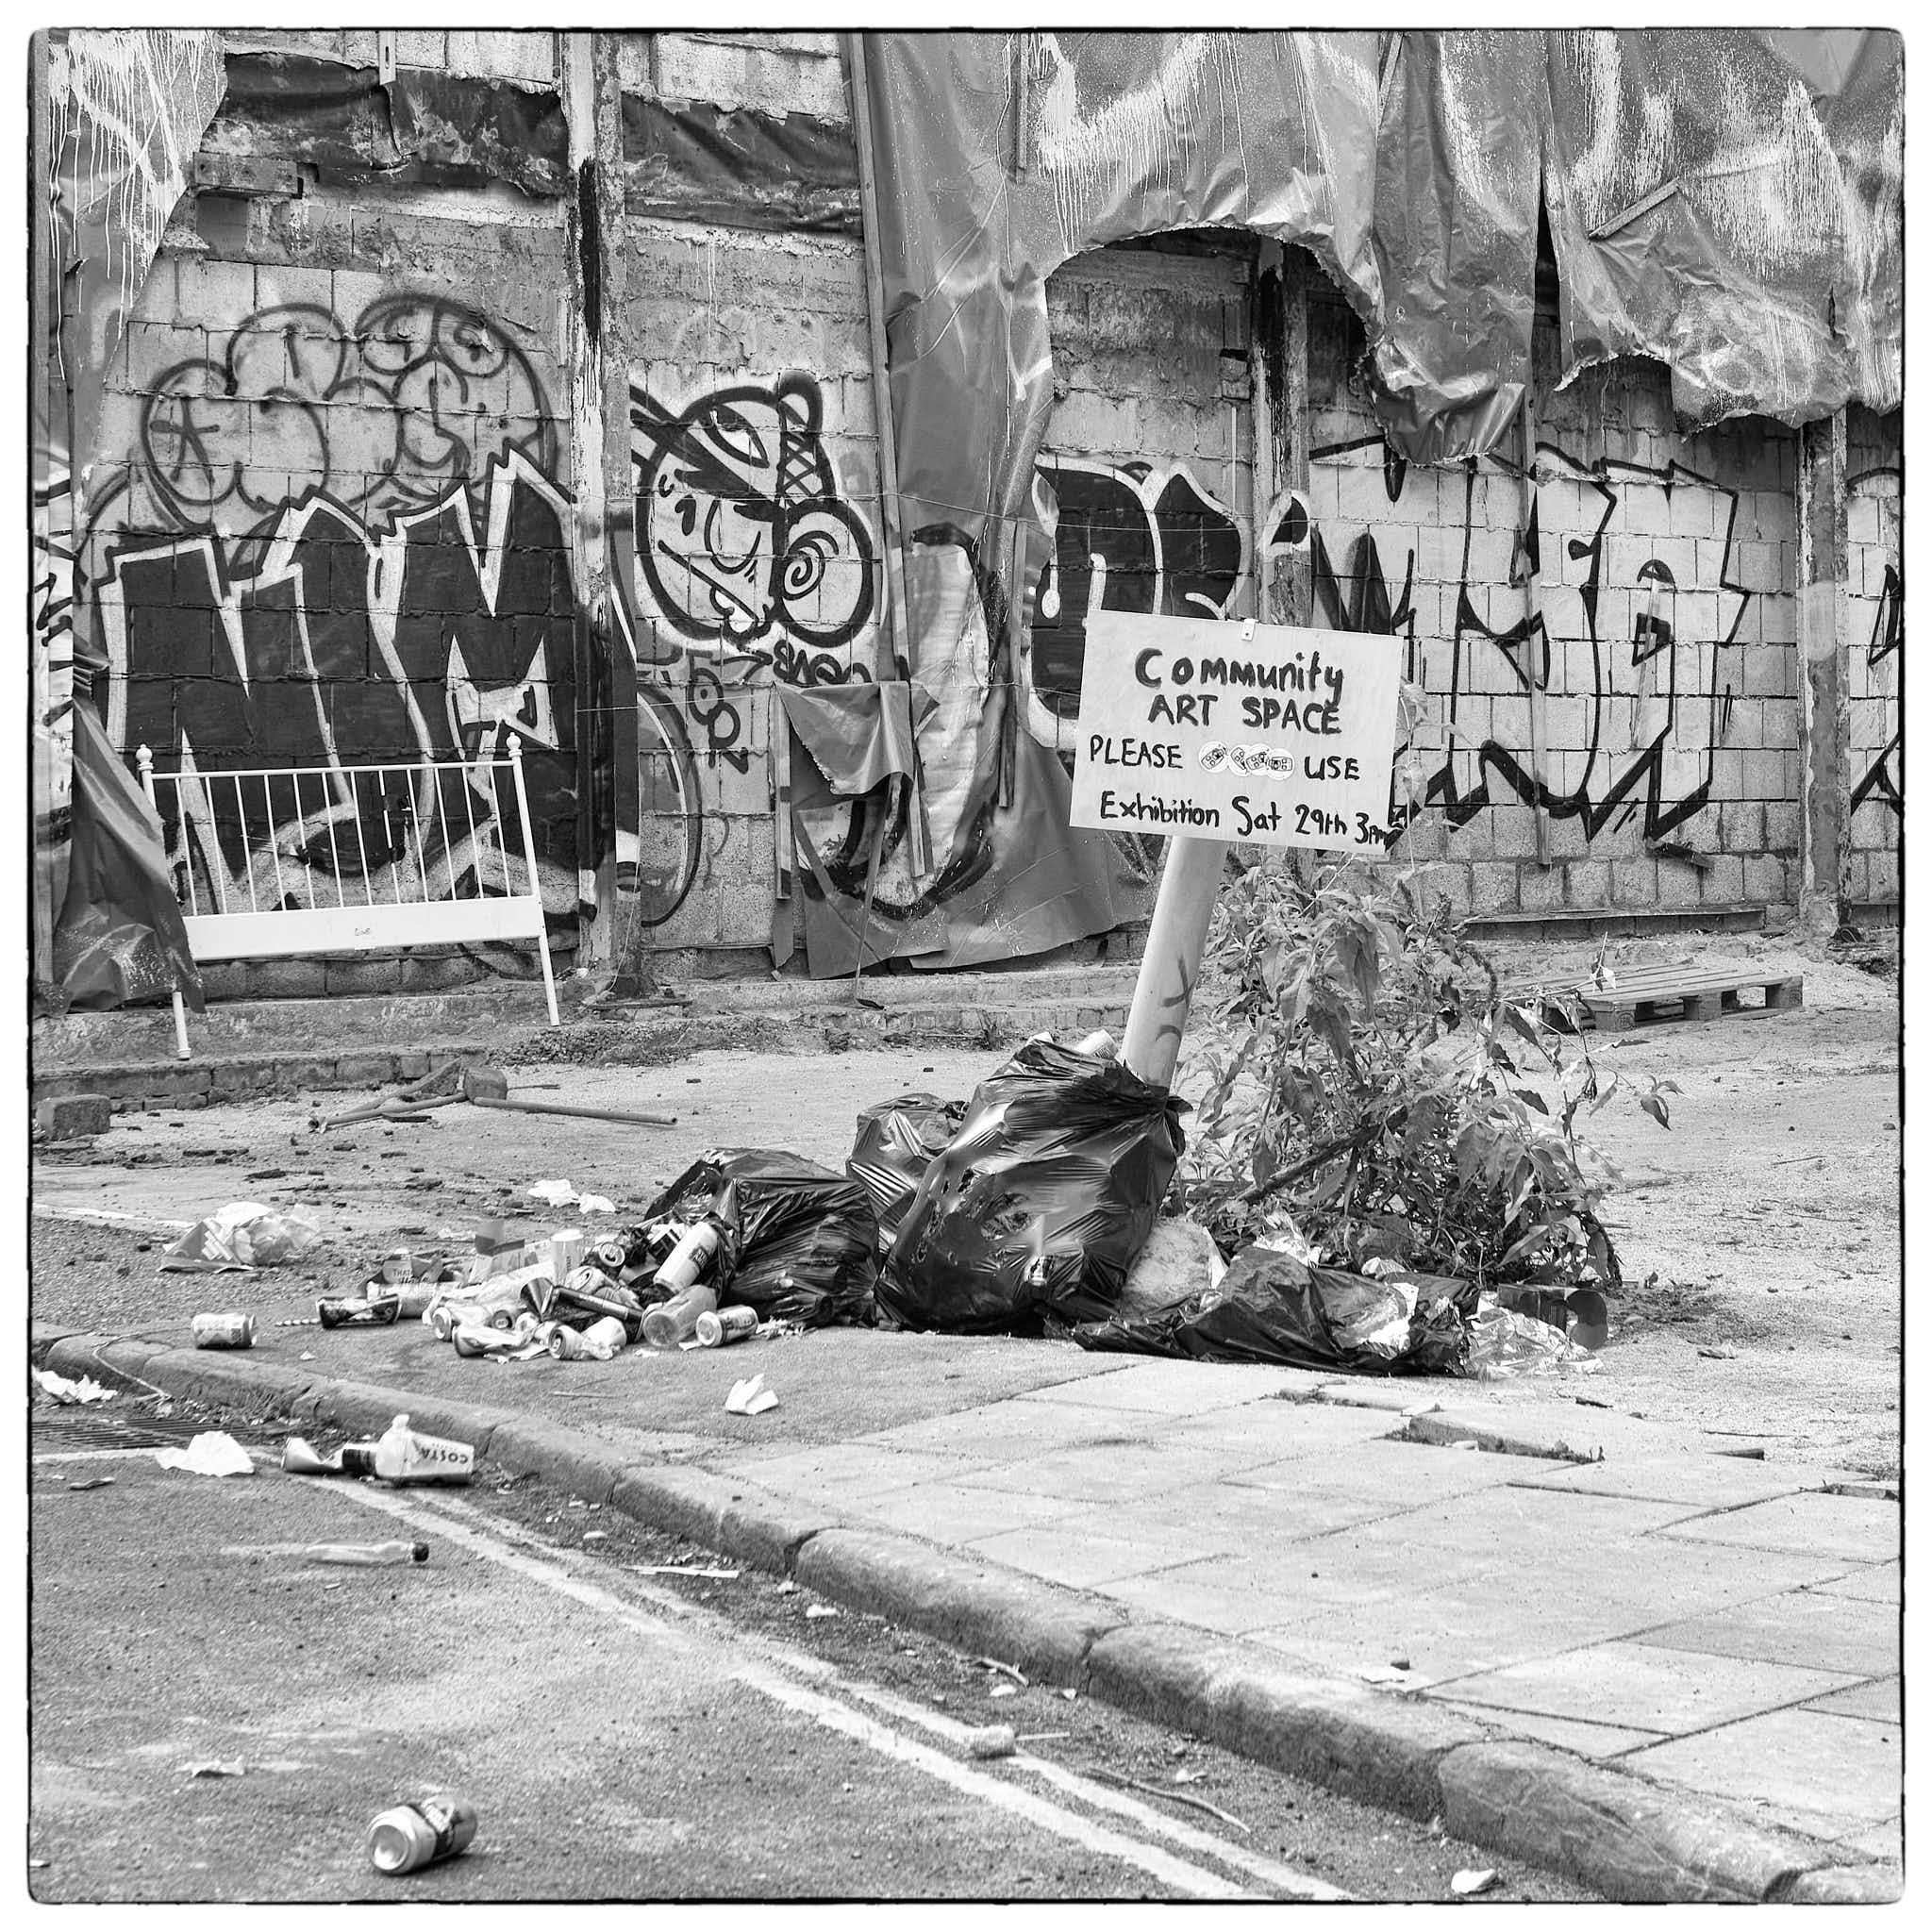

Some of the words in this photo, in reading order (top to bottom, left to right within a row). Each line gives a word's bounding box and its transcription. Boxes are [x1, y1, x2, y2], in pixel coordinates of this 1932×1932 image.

[1147, 693, 1219, 726] ART
[1241, 695, 1342, 735] SPACE
[1090, 734, 1184, 769] PLEASE
[1304, 756, 1360, 781] USE
[1099, 791, 1220, 827] Exhibition
[1231, 795, 1282, 836] Sat
[1294, 804, 1348, 836] 29th
[420, 1446, 470, 1465] COSTA
